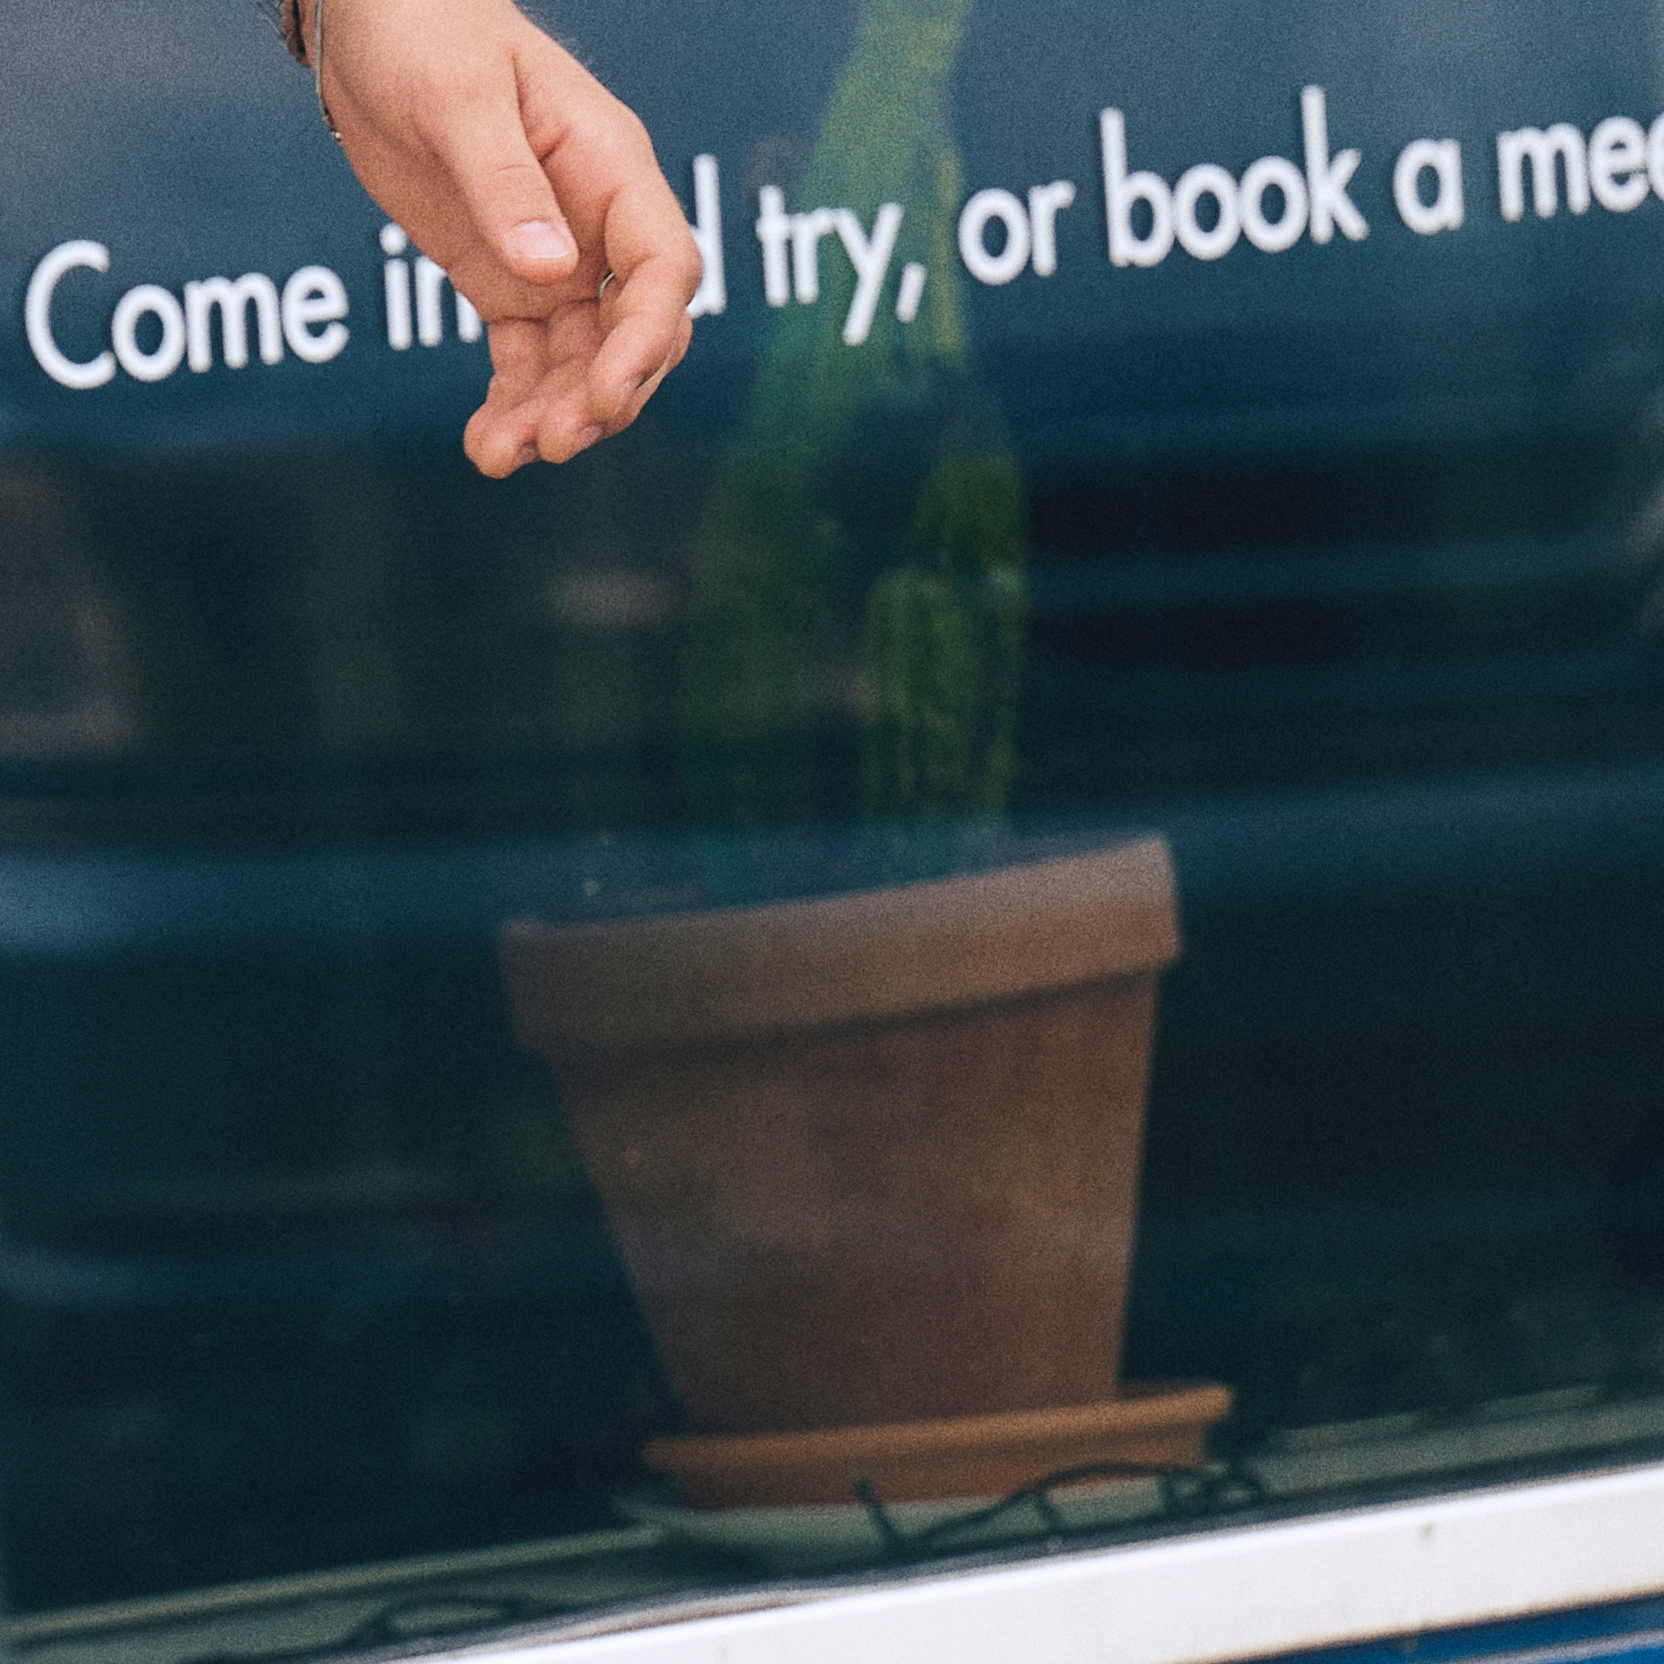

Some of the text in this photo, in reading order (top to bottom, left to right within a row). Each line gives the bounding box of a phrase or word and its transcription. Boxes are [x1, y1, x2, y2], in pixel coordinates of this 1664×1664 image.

[24, 238, 349, 389] Come
[756, 185, 926, 346] try,
[958, 180, 1075, 285] or
[1100, 83, 1368, 267] book
[1393, 138, 1465, 234] a
